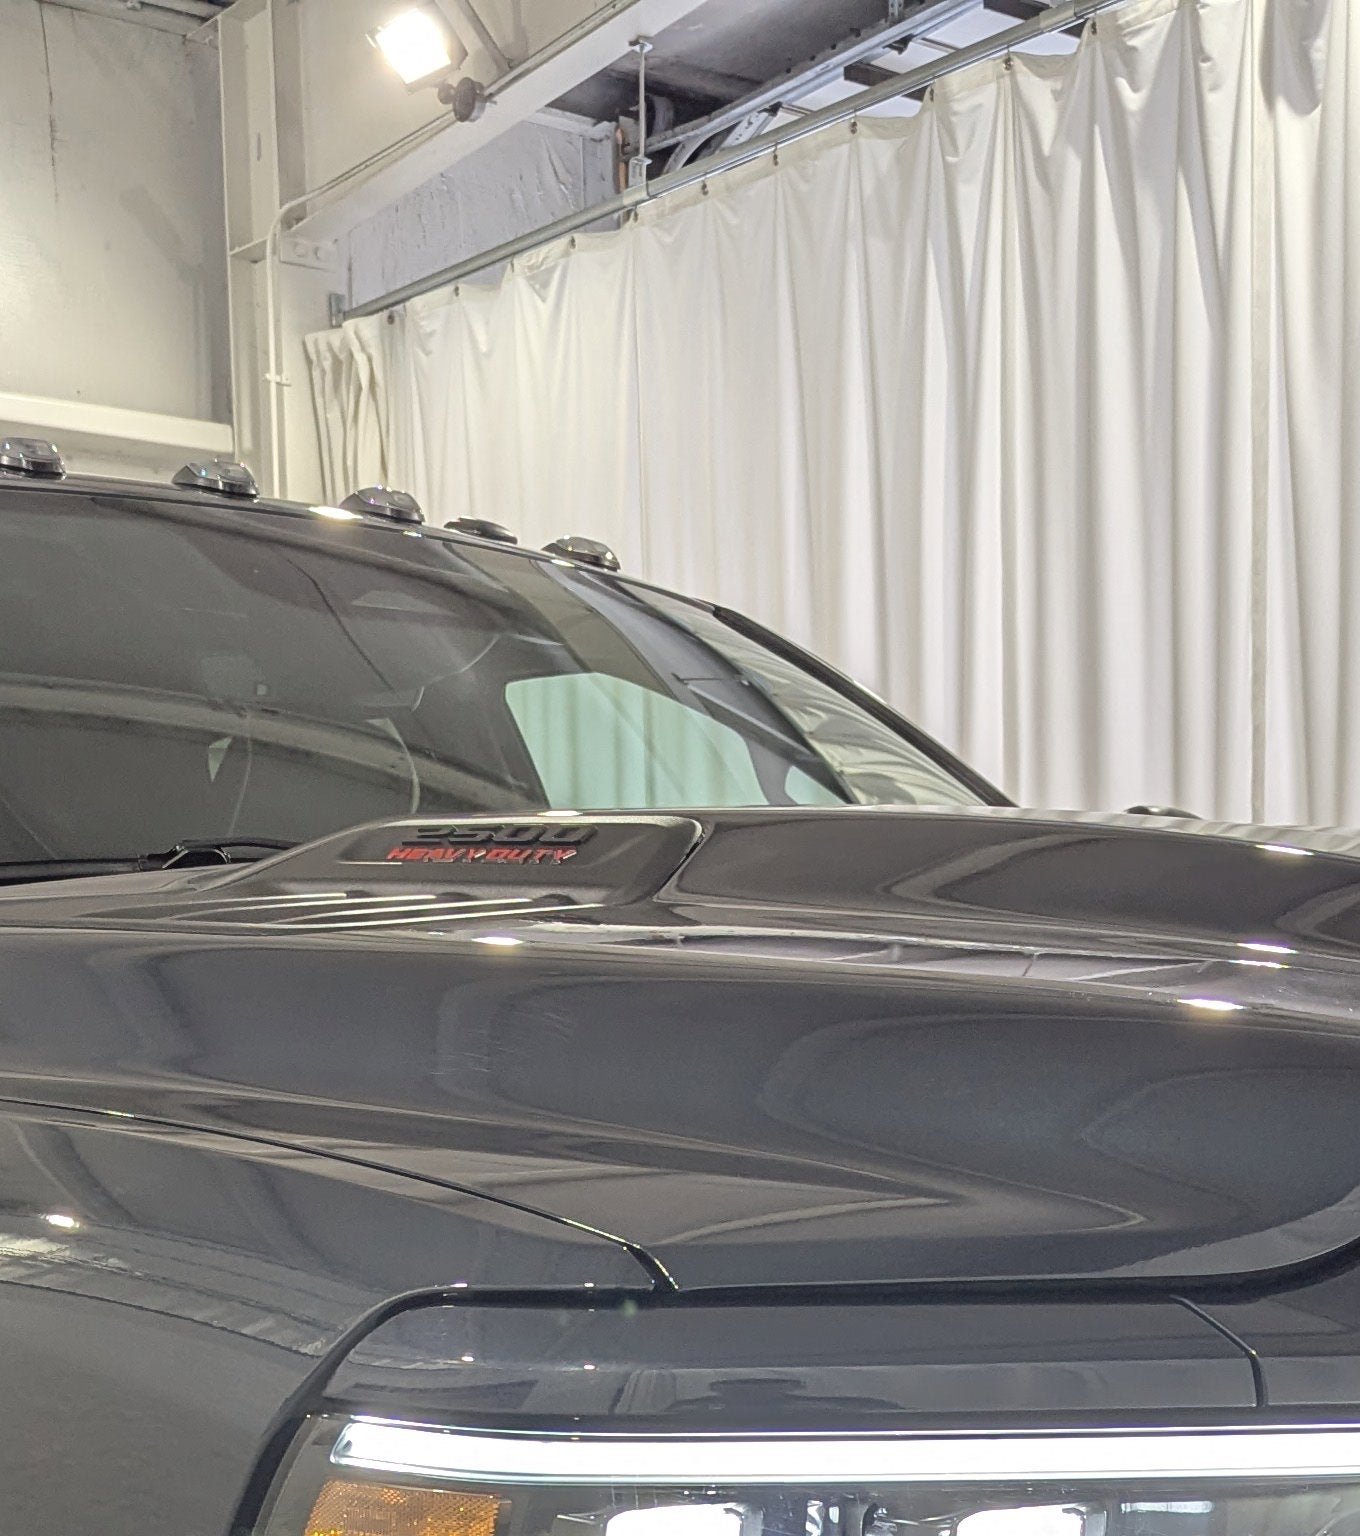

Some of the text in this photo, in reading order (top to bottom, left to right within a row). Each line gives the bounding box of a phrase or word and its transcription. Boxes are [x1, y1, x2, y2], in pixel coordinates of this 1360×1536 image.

[402, 825, 598, 847] 2500
[387, 847, 577, 865] HEAVY DUTY
